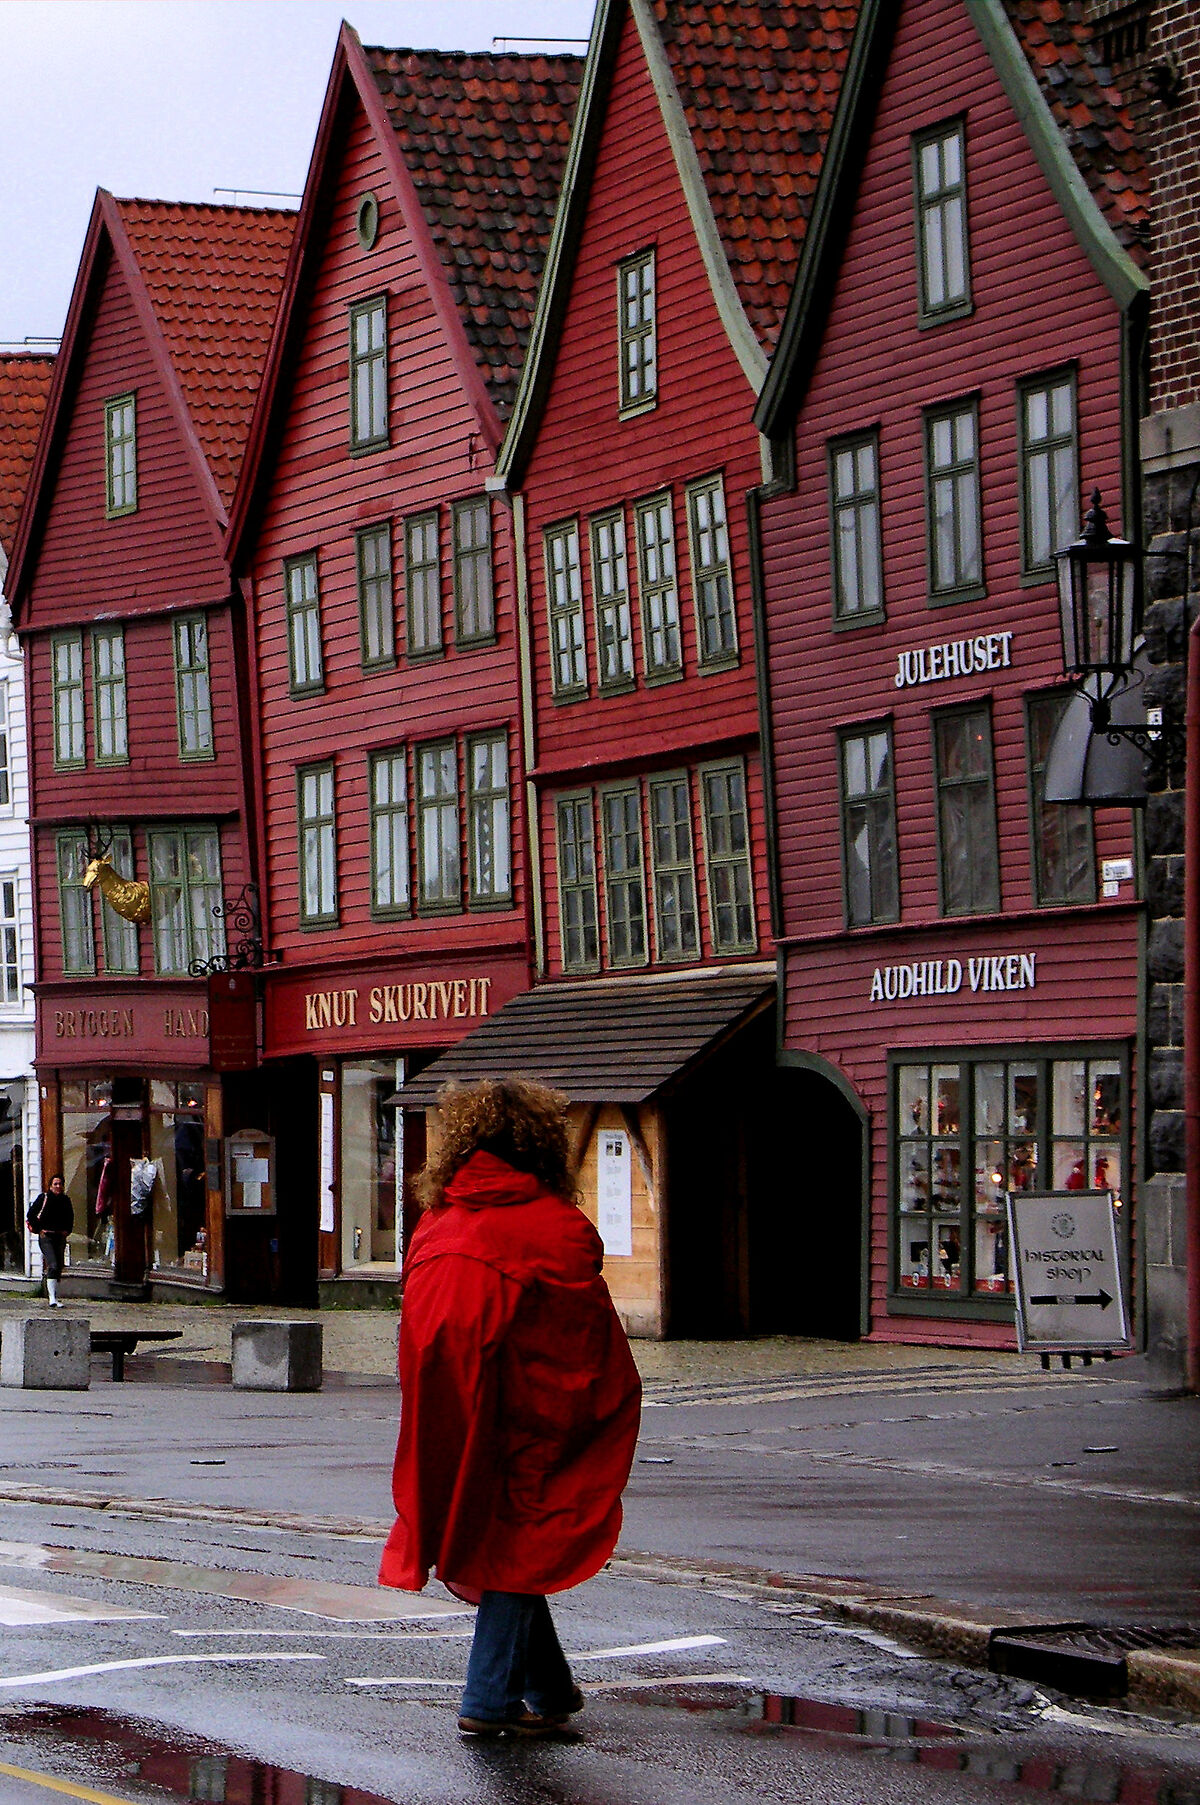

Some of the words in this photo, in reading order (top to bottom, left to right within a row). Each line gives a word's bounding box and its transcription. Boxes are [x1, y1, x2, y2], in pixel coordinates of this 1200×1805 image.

[895, 631, 1013, 688] JULEHUSET
[870, 959, 963, 1002] AUDHILD
[968, 953, 1037, 993] VIKEN
[55, 1009, 134, 1038] BRYGGEN
[305, 989, 358, 1030] KNUT
[369, 978, 491, 1023] SKURTVEIT
